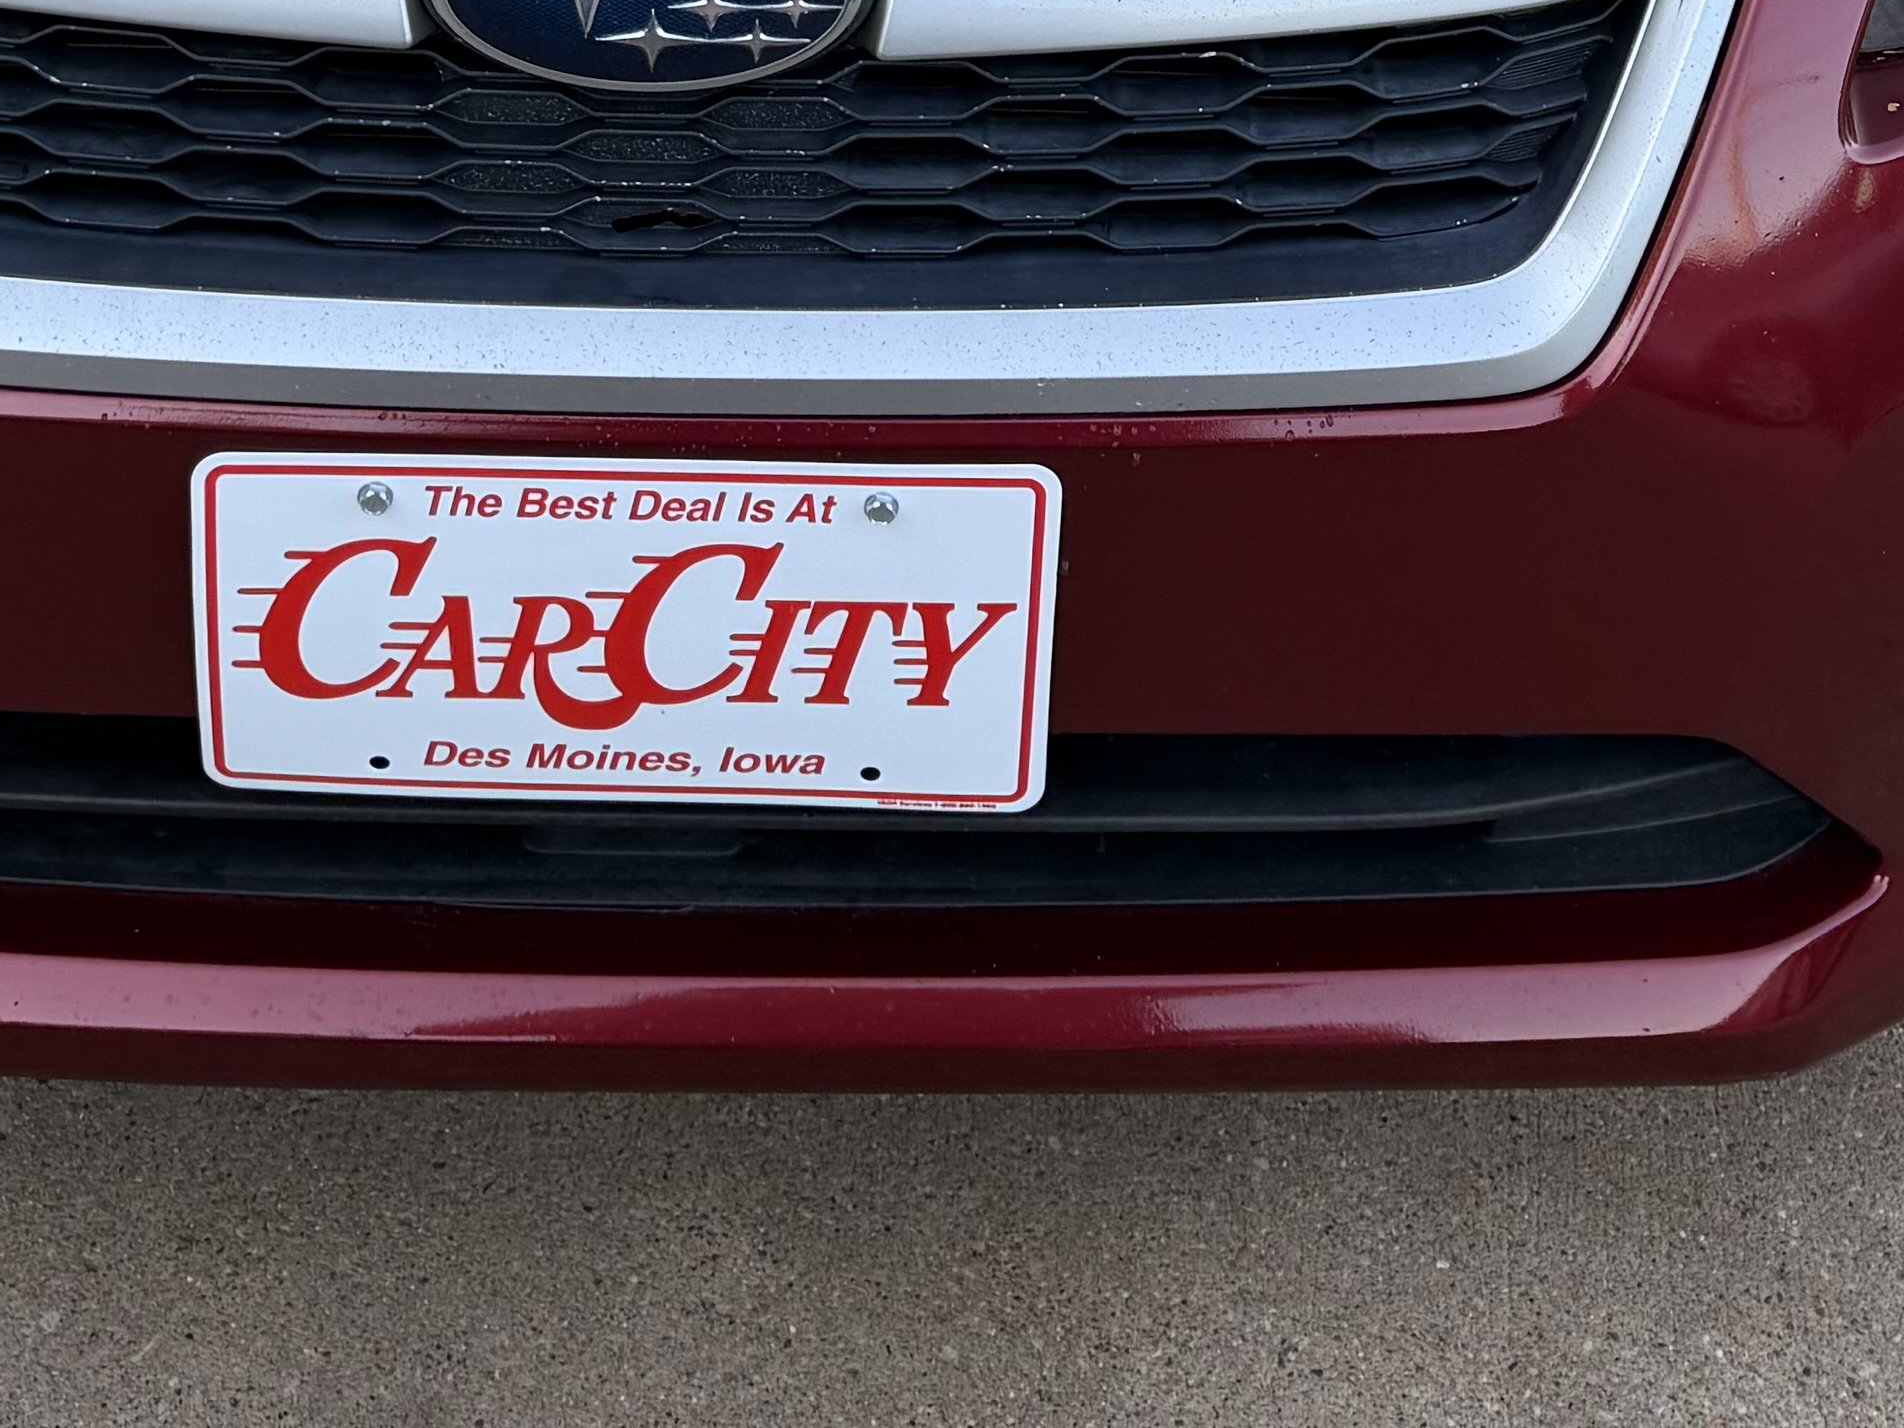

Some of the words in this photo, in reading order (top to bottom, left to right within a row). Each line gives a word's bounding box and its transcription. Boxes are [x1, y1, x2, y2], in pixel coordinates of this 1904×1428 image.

[423, 484, 503, 519] The
[516, 487, 617, 521] Best
[627, 489, 729, 523] Deal
[736, 491, 777, 524] Is
[784, 492, 839, 525] At
[422, 739, 513, 769] Des
[525, 742, 703, 778] Moines,
[718, 745, 828, 776] Iowa
